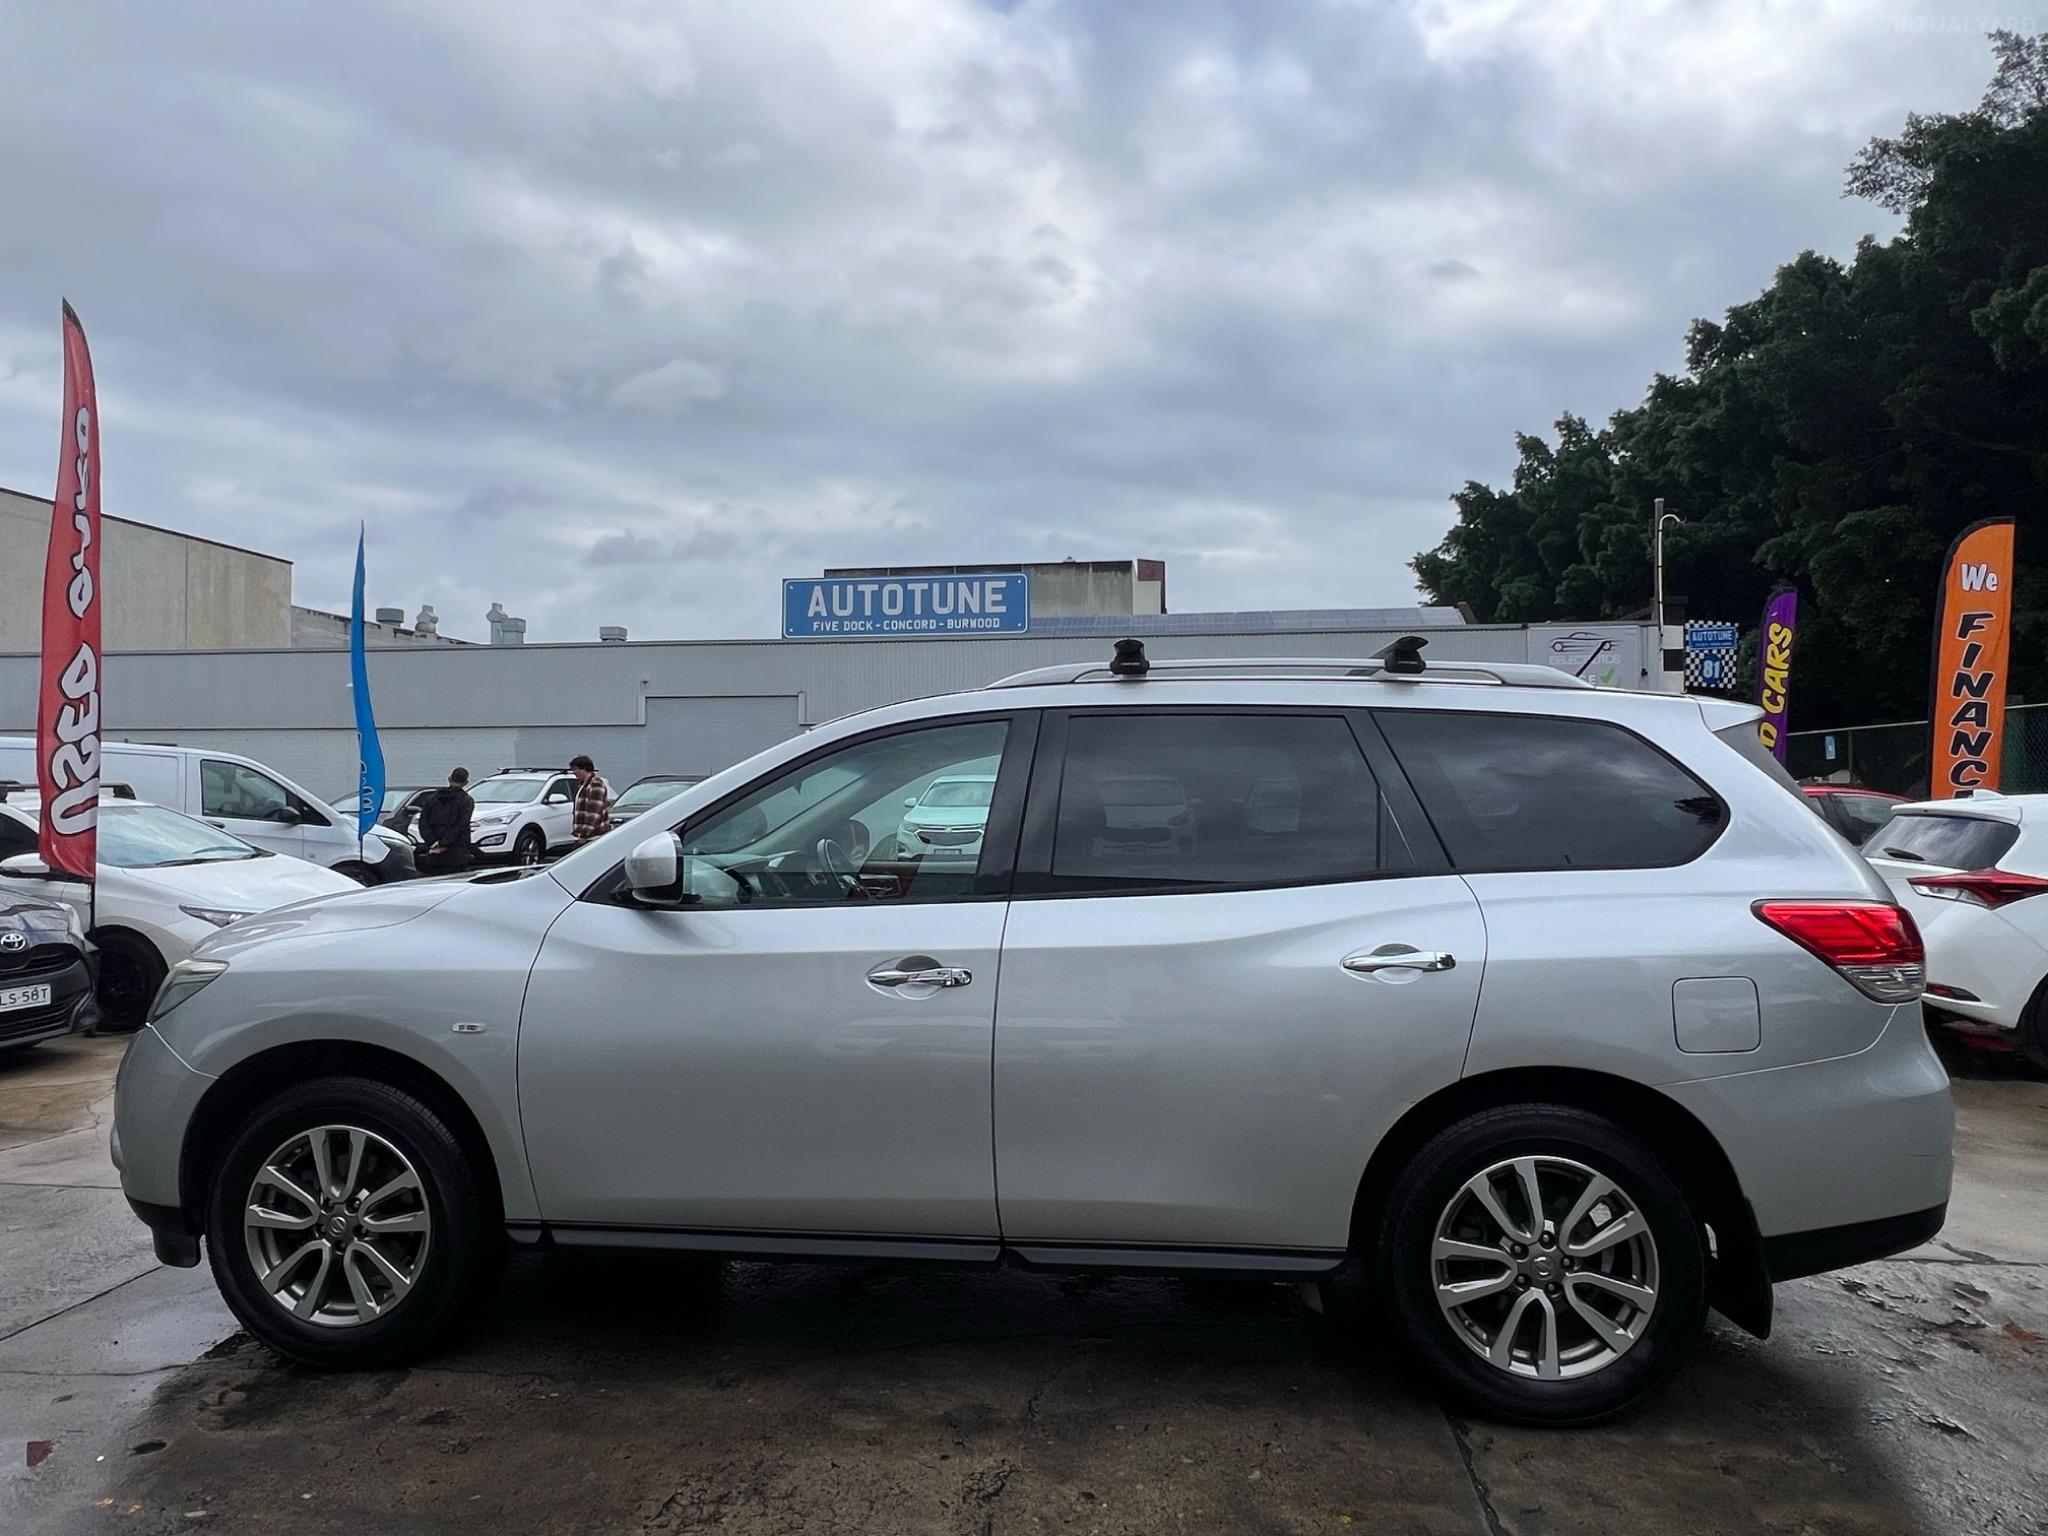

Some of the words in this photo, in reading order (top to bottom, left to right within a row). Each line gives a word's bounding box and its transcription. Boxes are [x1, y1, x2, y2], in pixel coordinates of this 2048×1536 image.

[1960, 563, 1998, 592] We
[807, 581, 1007, 617] AUTOTUNE
[813, 621, 839, 632] FIVE
[843, 620, 873, 631] DOCK
[883, 619, 936, 630] CONCORD
[946, 618, 1000, 629] BURWOOD
[1692, 630, 1733, 641] AUTOTUNE
[1703, 660, 1720, 678] 81
[1761, 622, 1793, 714] CARS
